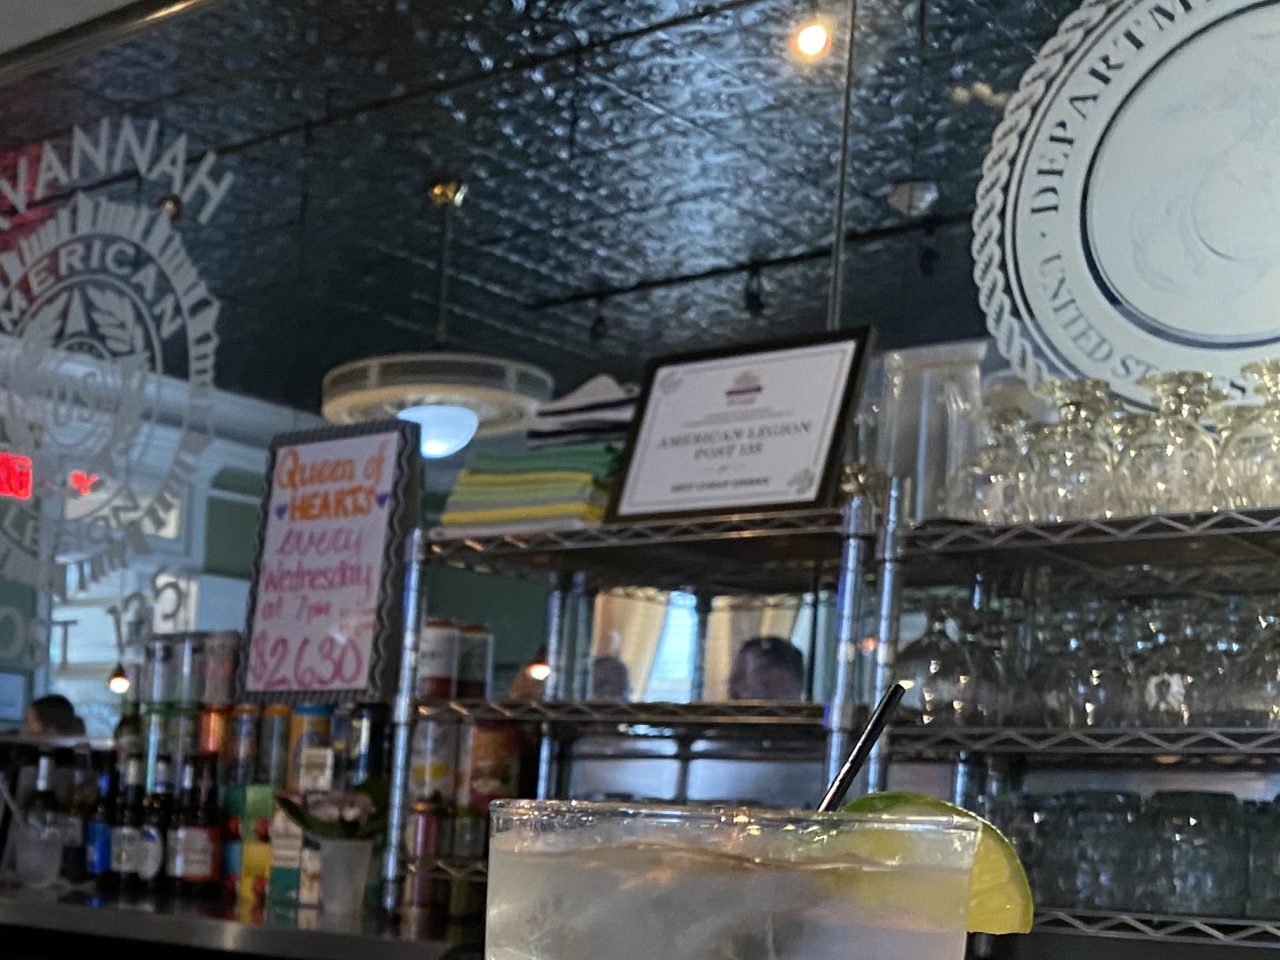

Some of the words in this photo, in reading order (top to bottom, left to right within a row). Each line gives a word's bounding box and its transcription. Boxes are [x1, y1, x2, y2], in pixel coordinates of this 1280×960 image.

[1039, 253, 1114, 364] UNITED
[276, 446, 355, 492] Queen
[363, 439, 392, 489] of
[249, 634, 363, 690] $2630
